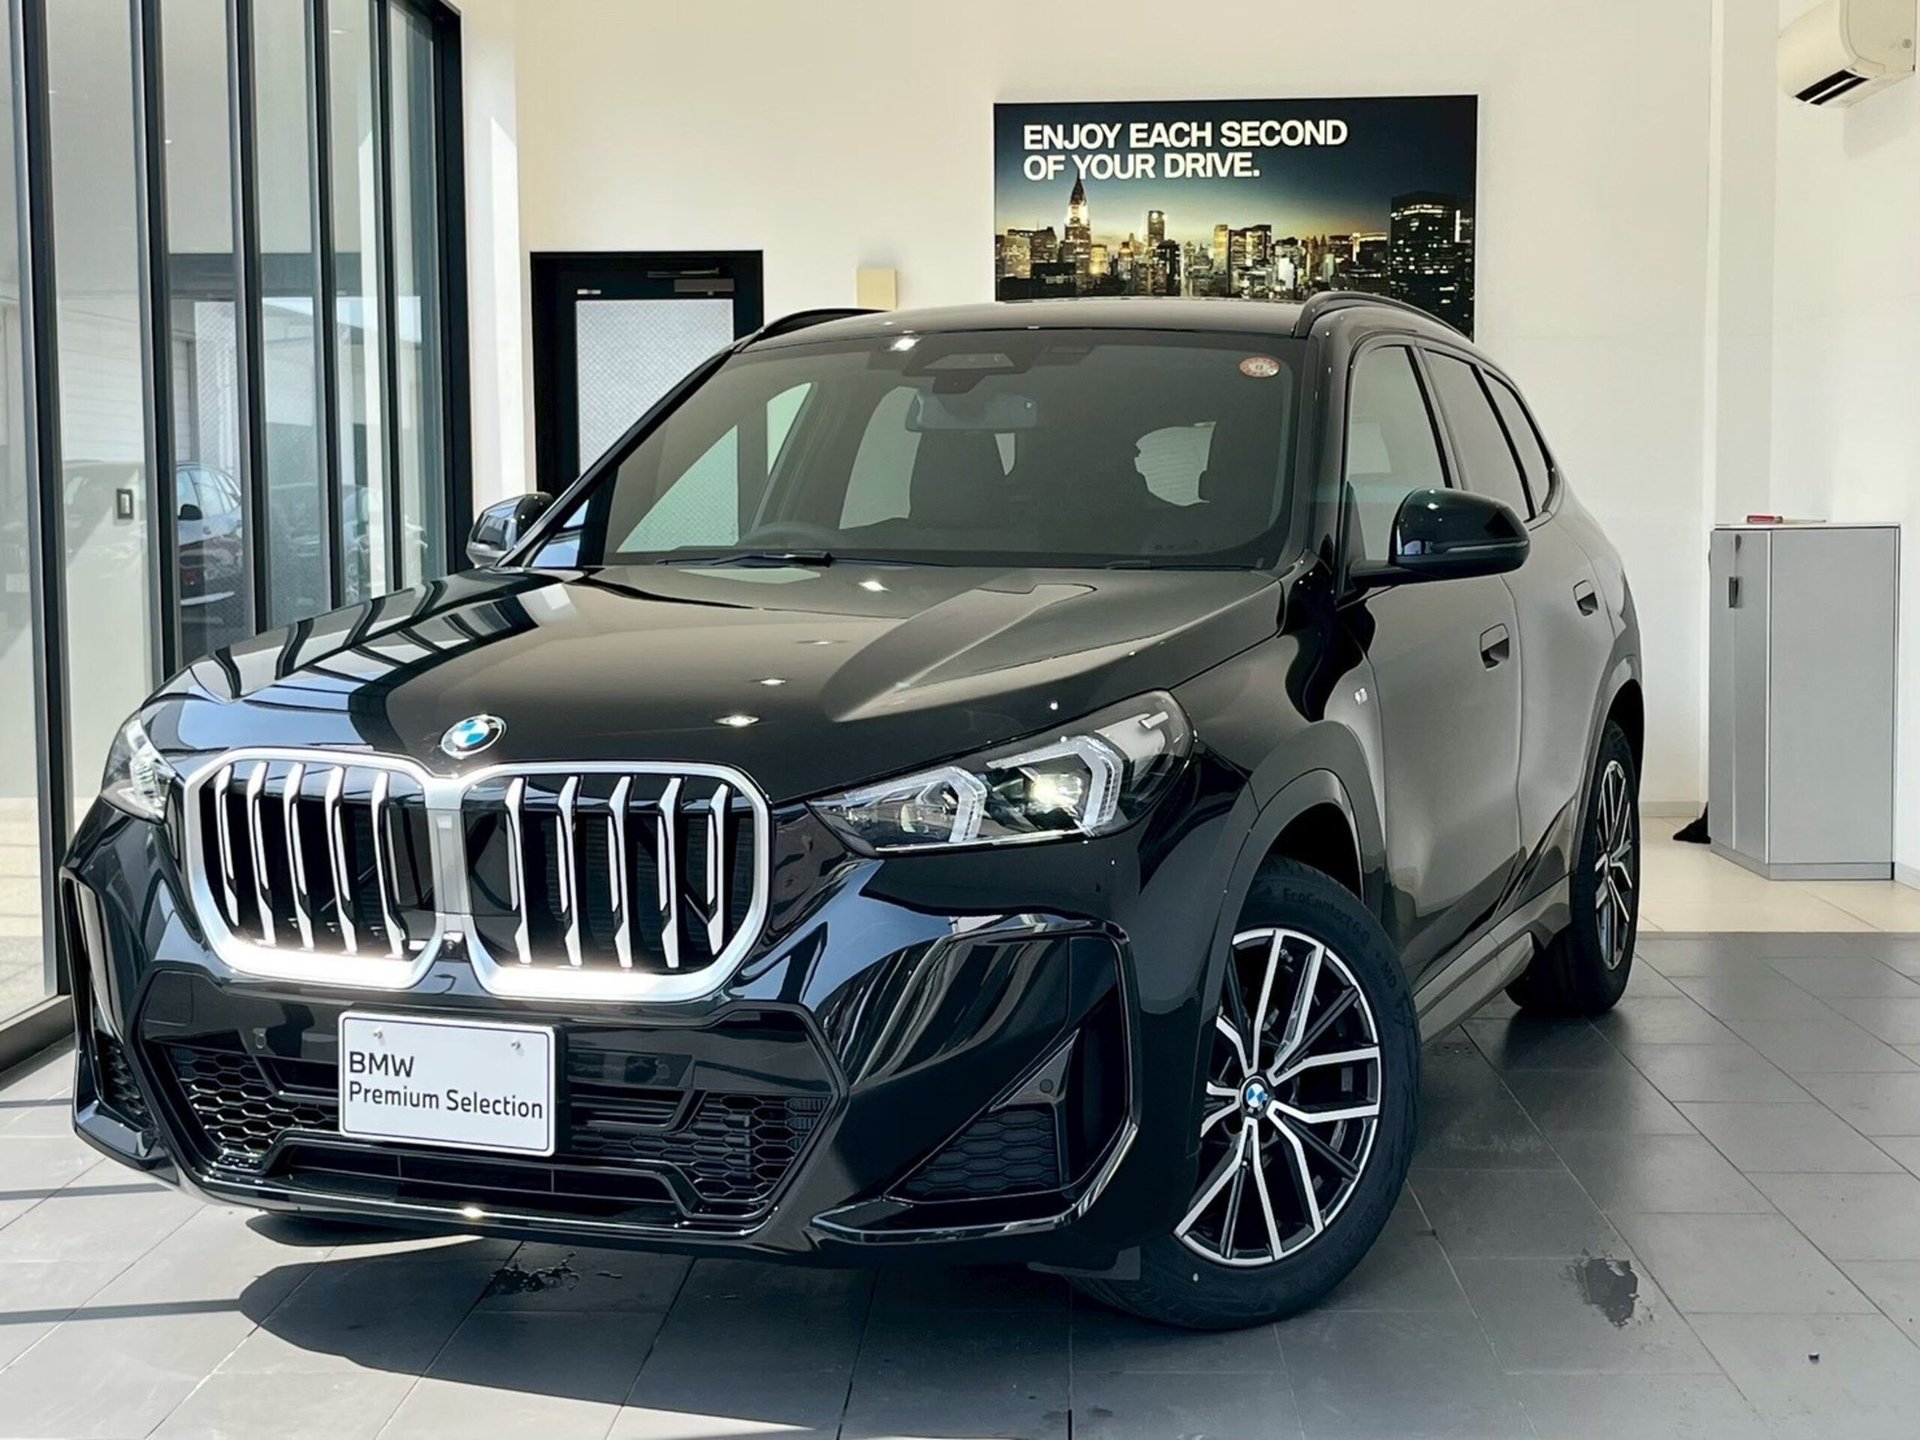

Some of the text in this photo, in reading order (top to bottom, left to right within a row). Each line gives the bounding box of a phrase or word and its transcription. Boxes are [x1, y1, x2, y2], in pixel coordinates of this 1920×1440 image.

[1024, 120, 1347, 149] ENJOY EACH SECOND
[1024, 152, 1259, 180] OF YOUR DRIVE.
[350, 1051, 414, 1077] BMW
[350, 1081, 542, 1119] Premium Selection
